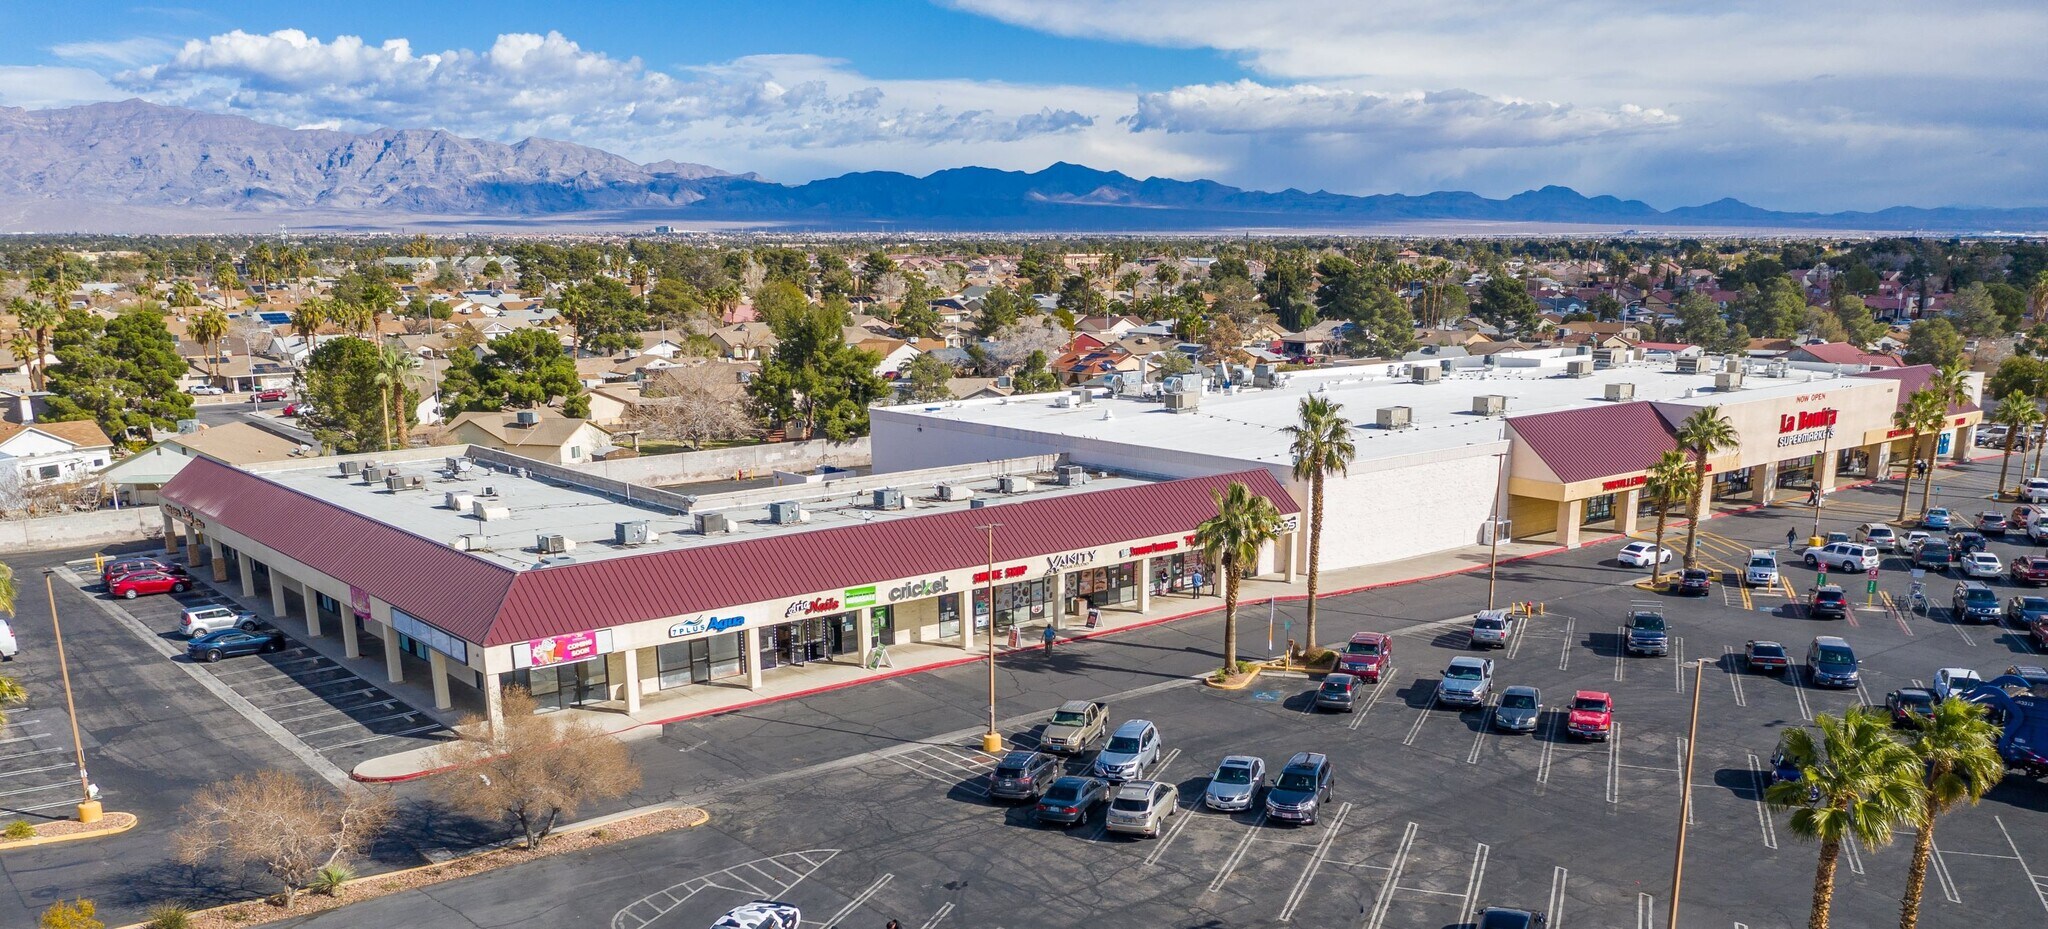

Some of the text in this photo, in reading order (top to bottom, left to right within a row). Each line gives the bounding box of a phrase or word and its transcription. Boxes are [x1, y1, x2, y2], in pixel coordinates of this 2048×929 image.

[1811, 393, 1826, 401] OPEN
[1779, 414, 1795, 434] La
[1045, 550, 1096, 571] VANITY
[1005, 565, 1027, 579] SHOP
[888, 576, 948, 601] cricket
[804, 597, 839, 615] Nails
[679, 625, 705, 633] PLUS
[567, 639, 593, 651] COMING
[571, 647, 590, 657] SOON
